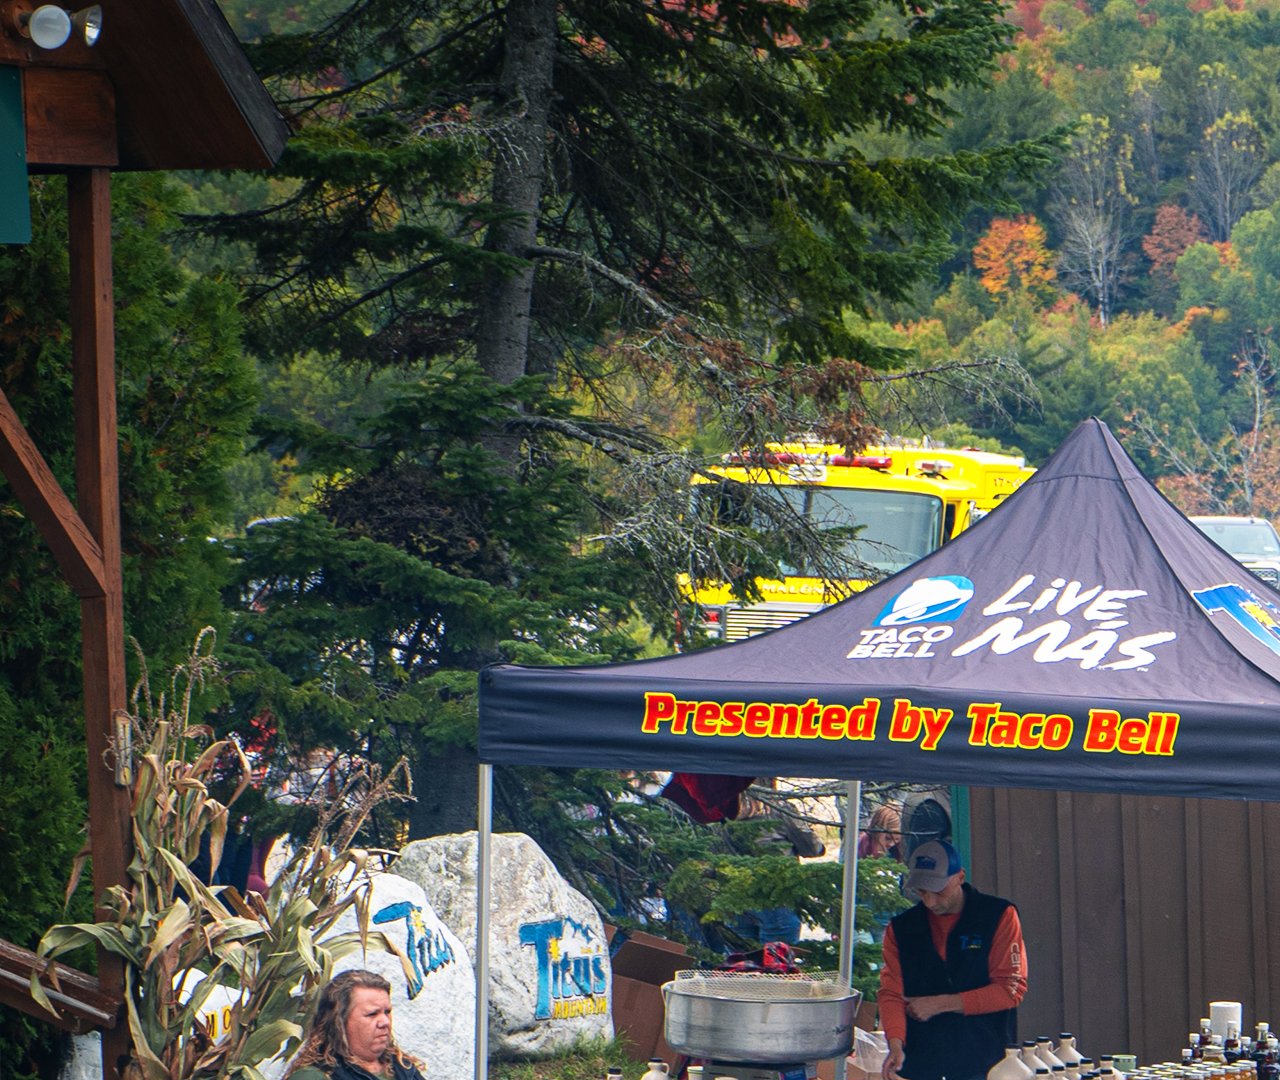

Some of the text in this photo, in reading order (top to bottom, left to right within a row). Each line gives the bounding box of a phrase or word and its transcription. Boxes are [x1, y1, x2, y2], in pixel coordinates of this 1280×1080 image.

[762, 583, 827, 595] MALON
[859, 626, 954, 644] TACO
[846, 642, 936, 659] BELL
[641, 692, 1181, 757] Presented by Taco Bell
